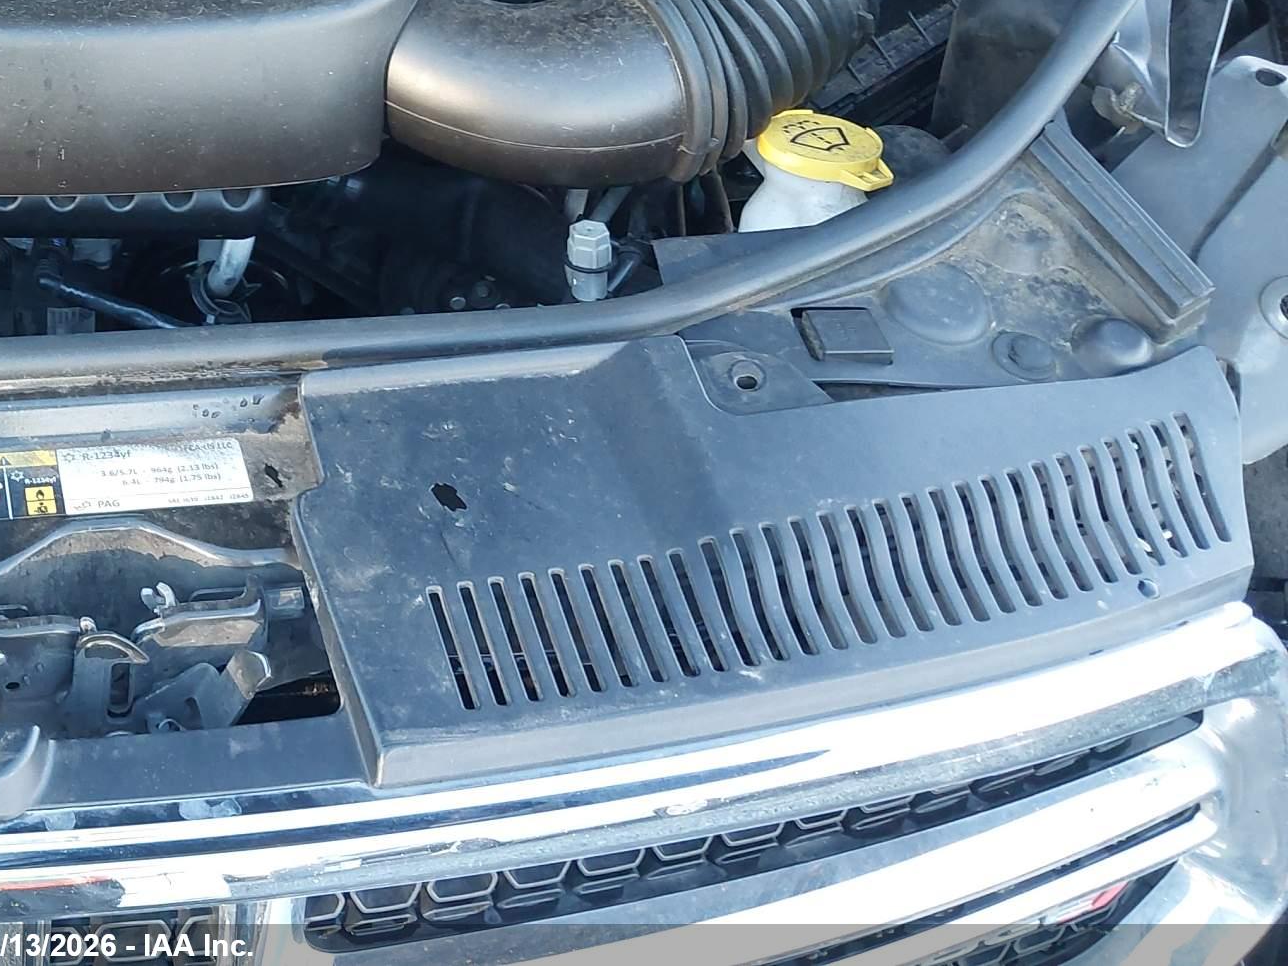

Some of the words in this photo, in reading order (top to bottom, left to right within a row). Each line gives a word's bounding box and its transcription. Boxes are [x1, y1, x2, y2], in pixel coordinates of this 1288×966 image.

[83, 450, 131, 461] R-1234yf
[178, 464, 200, 472] (2.13
[202, 463, 219, 471] lbs)
[180, 474, 202, 482] (1.75
[204, 473, 221, 481] lbs)
[98, 500, 120, 508] PAG
